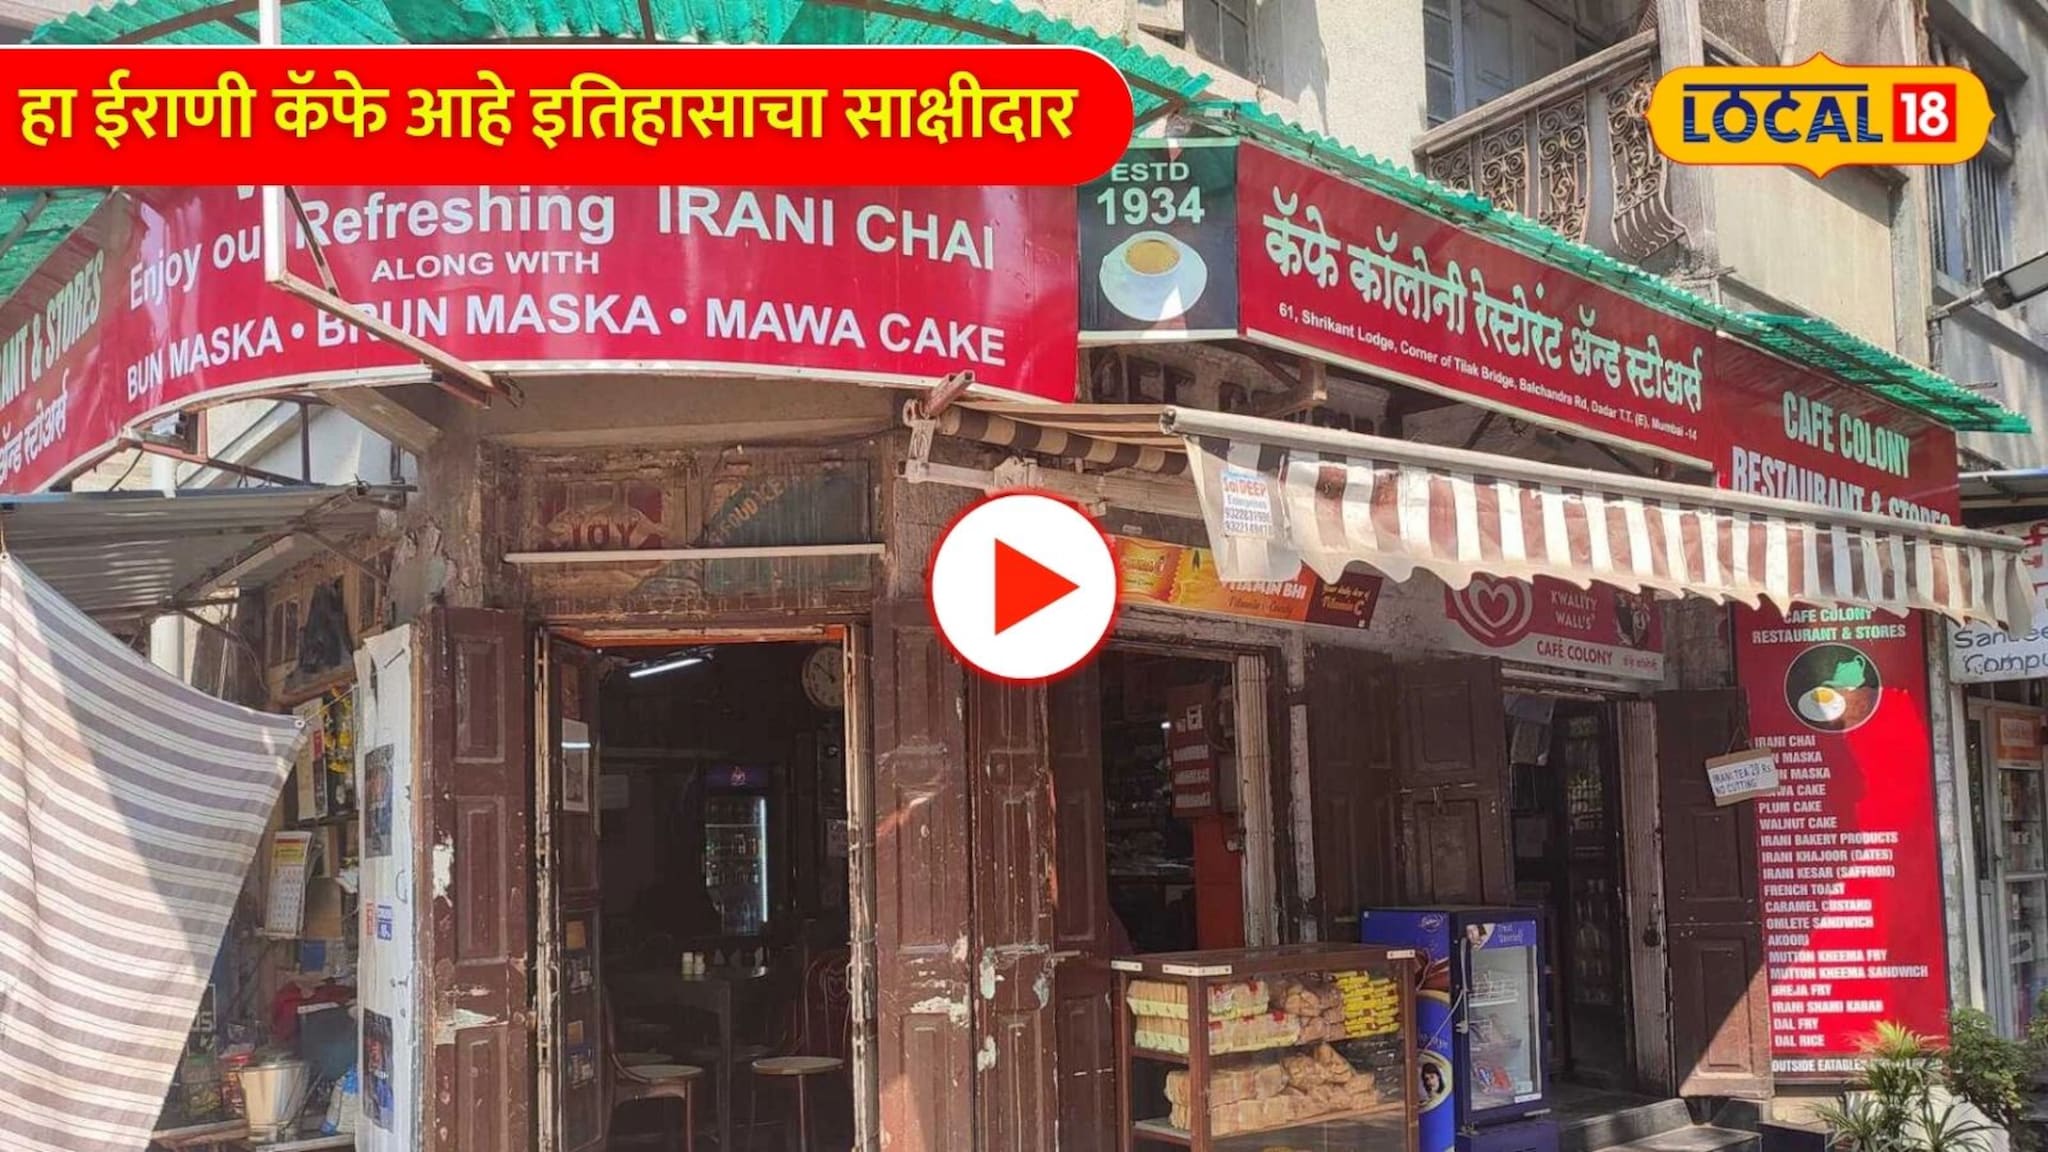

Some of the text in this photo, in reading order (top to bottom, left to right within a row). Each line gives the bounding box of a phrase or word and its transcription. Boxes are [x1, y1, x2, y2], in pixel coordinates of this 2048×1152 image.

[1111, 162, 1190, 181] ESTD
[1097, 186, 1205, 225] 1934
[130, 186, 993, 311] Enjoy ou Refreshing IRANI CHAI
[371, 251, 599, 282] ALONG WITH
[1263, 186, 1341, 288] कॅफे
[1347, 225, 1468, 335] कॉलोनी
[1471, 267, 1563, 369] रेस्टोरंट
[1624, 334, 1703, 413] स्टोअर्स
[32, 313, 43, 383] &
[46, 249, 104, 369] STORES
[127, 349, 163, 403] BUN
[169, 316, 283, 379] MASKA
[466, 293, 661, 335] MASKA
[706, 298, 866, 349] MAWA
[879, 313, 1006, 367] CAKE
[1279, 302, 1298, 324] 61,
[1302, 310, 1354, 338] Shrikant
[1358, 326, 1397, 353] Lodge,
[1400, 340, 1438, 364] Corner
[1440, 356, 1452, 368] of
[1455, 356, 1479, 376] Tilak
[1480, 366, 1518, 389] Bridge,
[1519, 378, 1572, 406] Balchandra
[1591, 400, 1617, 418] Dadar
[1651, 417, 1684, 437] Mumbai
[1783, 391, 1909, 479] CAFE COLONY
[1732, 446, 1865, 514] RESTAURANT
[1820, 607, 1872, 622] COLONY
[1752, 624, 1906, 644] RESTAURANT & STORES
[1567, 645, 1613, 665] COLONY
[1755, 735, 1816, 748] IRANI CHAI
[1782, 751, 1822, 763] MASKA
[1790, 767, 1831, 780] MASKA
[1797, 784, 1826, 796] CAKE
[1759, 801, 1822, 814] PLUM CAKE
[1760, 816, 1837, 831] WALNUT CAKE
[1761, 831, 1898, 847] IRANI BAKERY PRODUCTS
[1762, 848, 1893, 863] IRANI KHAJOOR (DATES)
[1763, 868, 1794, 880] IRANI
[1797, 867, 1833, 879] KESAR
[1764, 882, 1845, 897] FRENCH TOAST
[1765, 900, 1818, 913] CARAMEL
[1766, 915, 1874, 930] OMLETE SANDWICH
[1769, 950, 1815, 963] MUTTON
[1866, 949, 1887, 962] FRY
[1770, 967, 1816, 980] MUTTON
[1867, 965, 1928, 978] SANDWICH
[1810, 983, 1832, 996] FRY
[1772, 1001, 1804, 1014] IRANI
[1773, 1017, 1818, 1030] DAL FRY
[1775, 1034, 1825, 1047] DAL RICE
[1771, 1059, 1815, 1072] OUTSIDE
